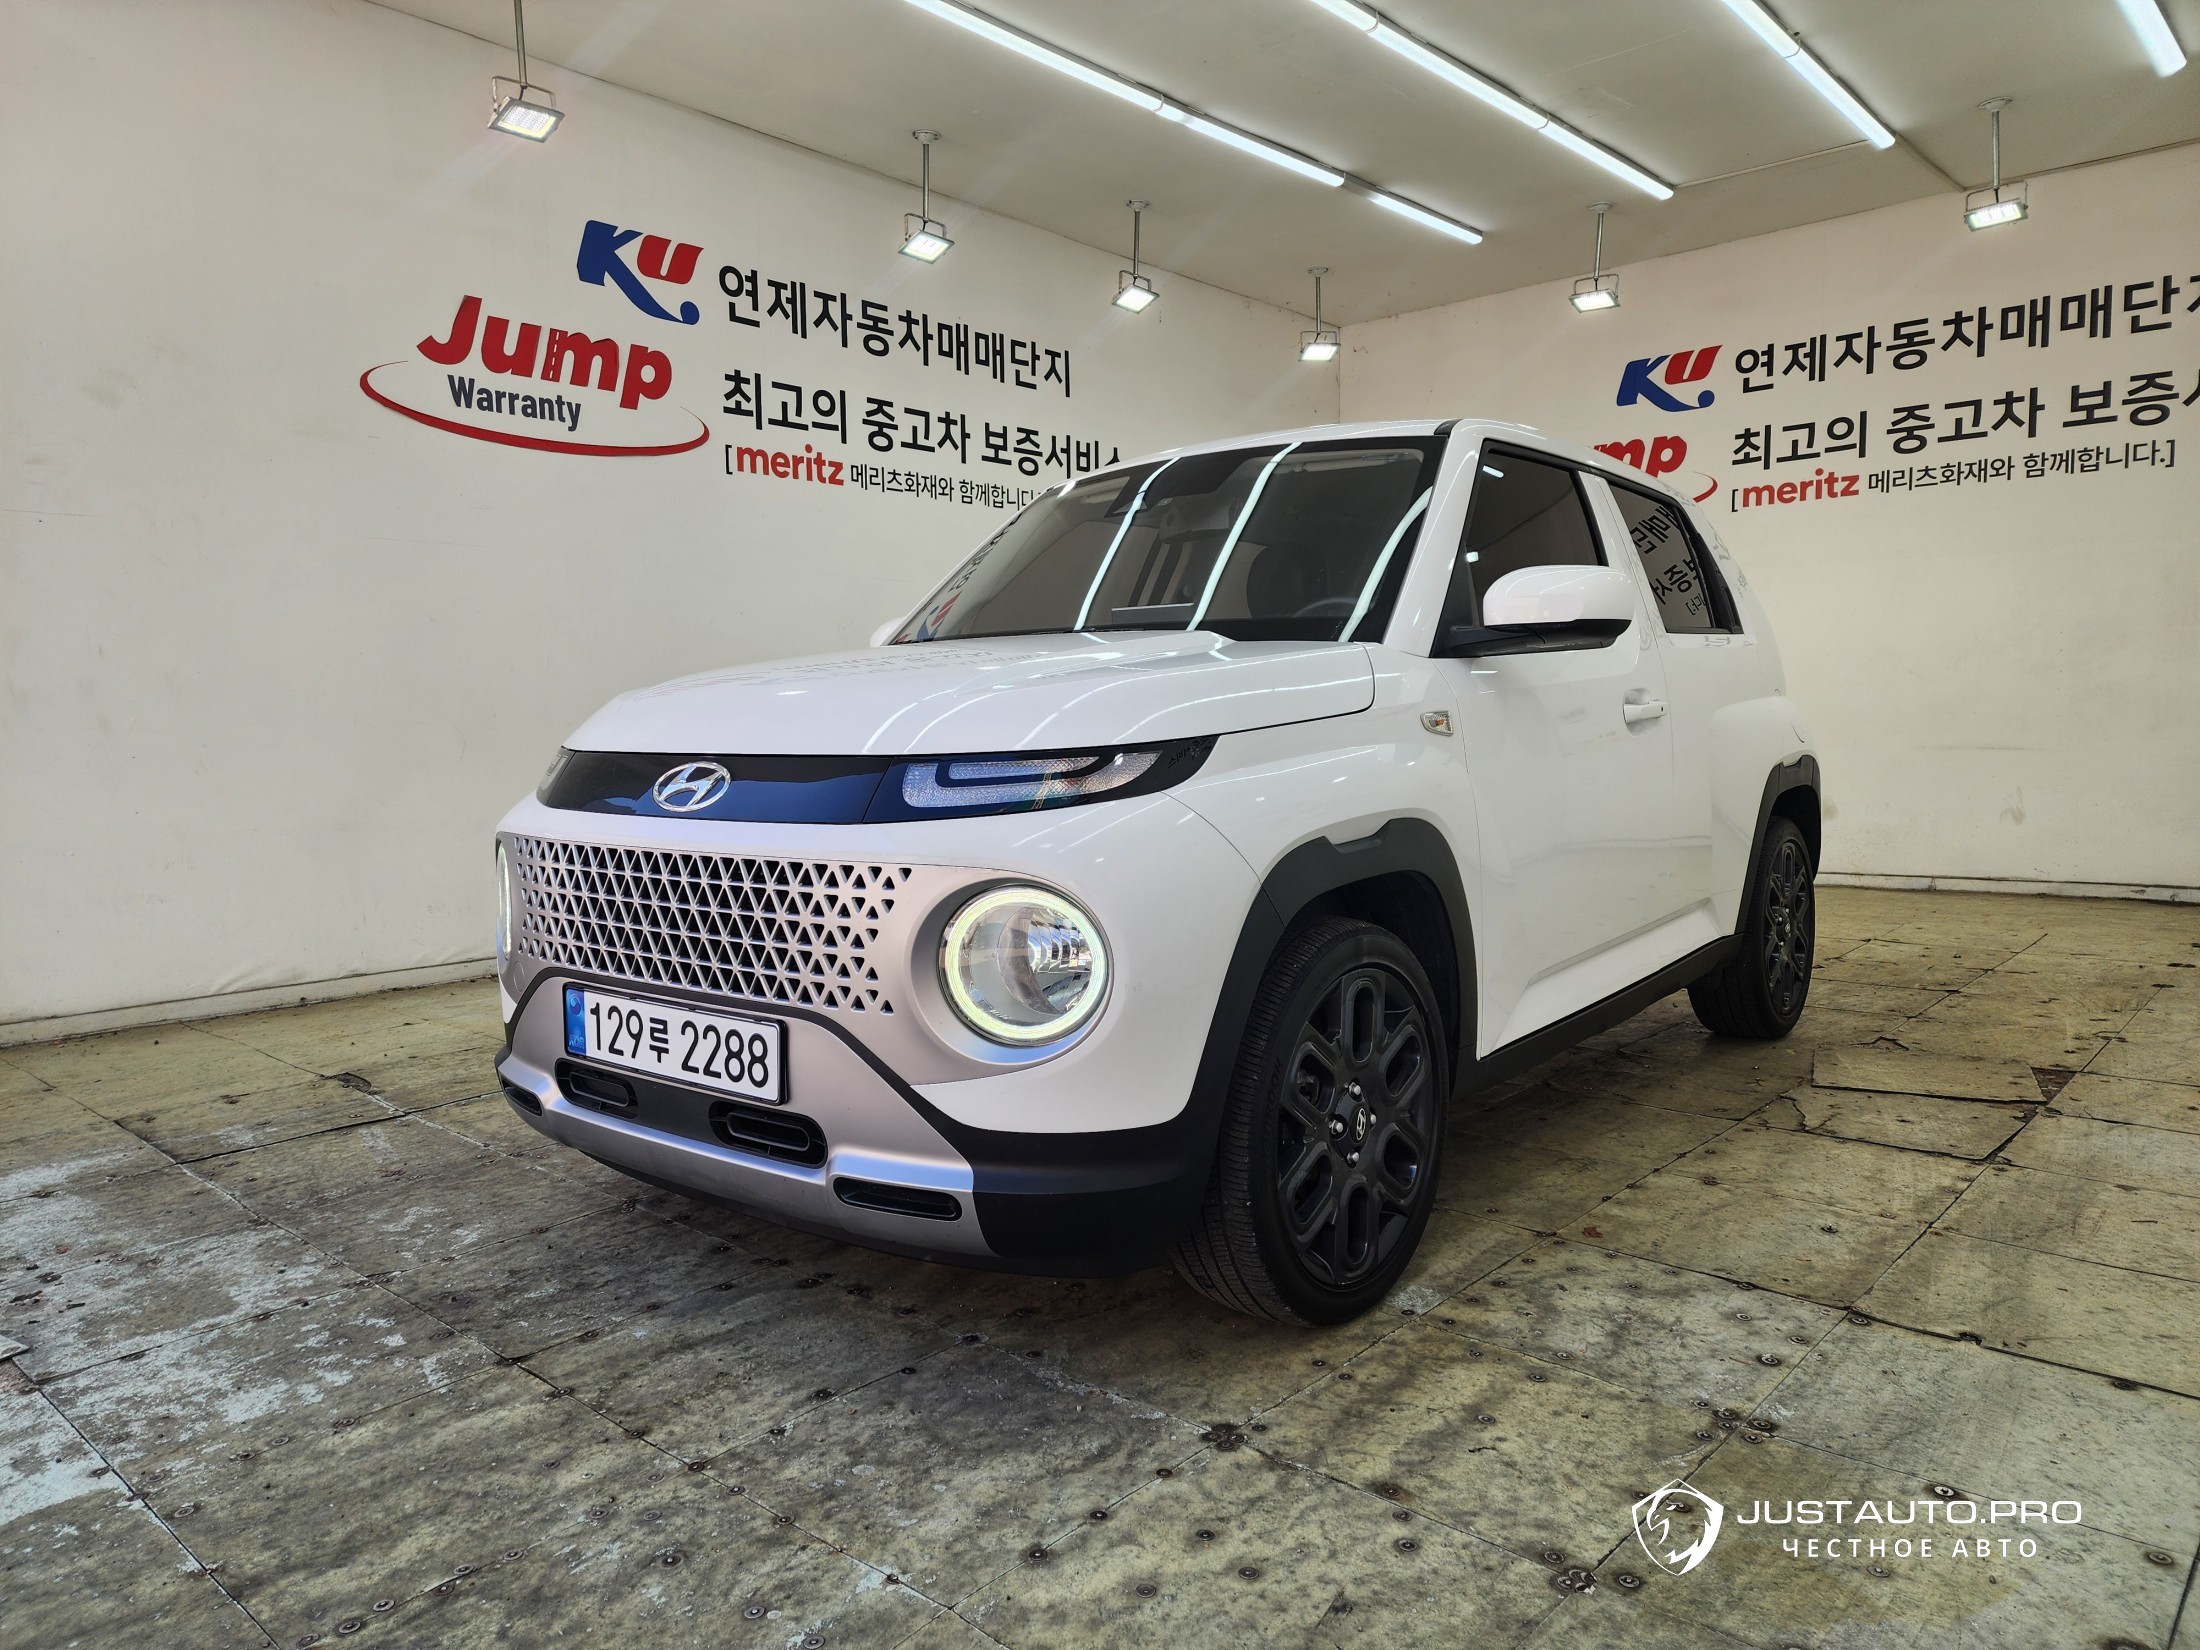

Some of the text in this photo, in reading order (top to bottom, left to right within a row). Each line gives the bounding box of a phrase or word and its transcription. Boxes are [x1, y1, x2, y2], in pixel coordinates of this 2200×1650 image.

[416, 294, 672, 411] Jump
[718, 264, 1072, 399] 연제자동차매매단지
[447, 374, 582, 432] Warranty
[722, 368, 848, 445] 최고의
[861, 396, 971, 464] 중고차
[1731, 409, 1868, 471] 최고의
[1885, 385, 2046, 455] 중고차
[850, 463, 955, 503] 메리츠화재와
[959, 479, 1042, 512] 함께합니다
[1594, 435, 1688, 478] mp
[1867, 456, 2016, 495] 메리츠화재와
[589, 1001, 769, 1089] 129루 2288
